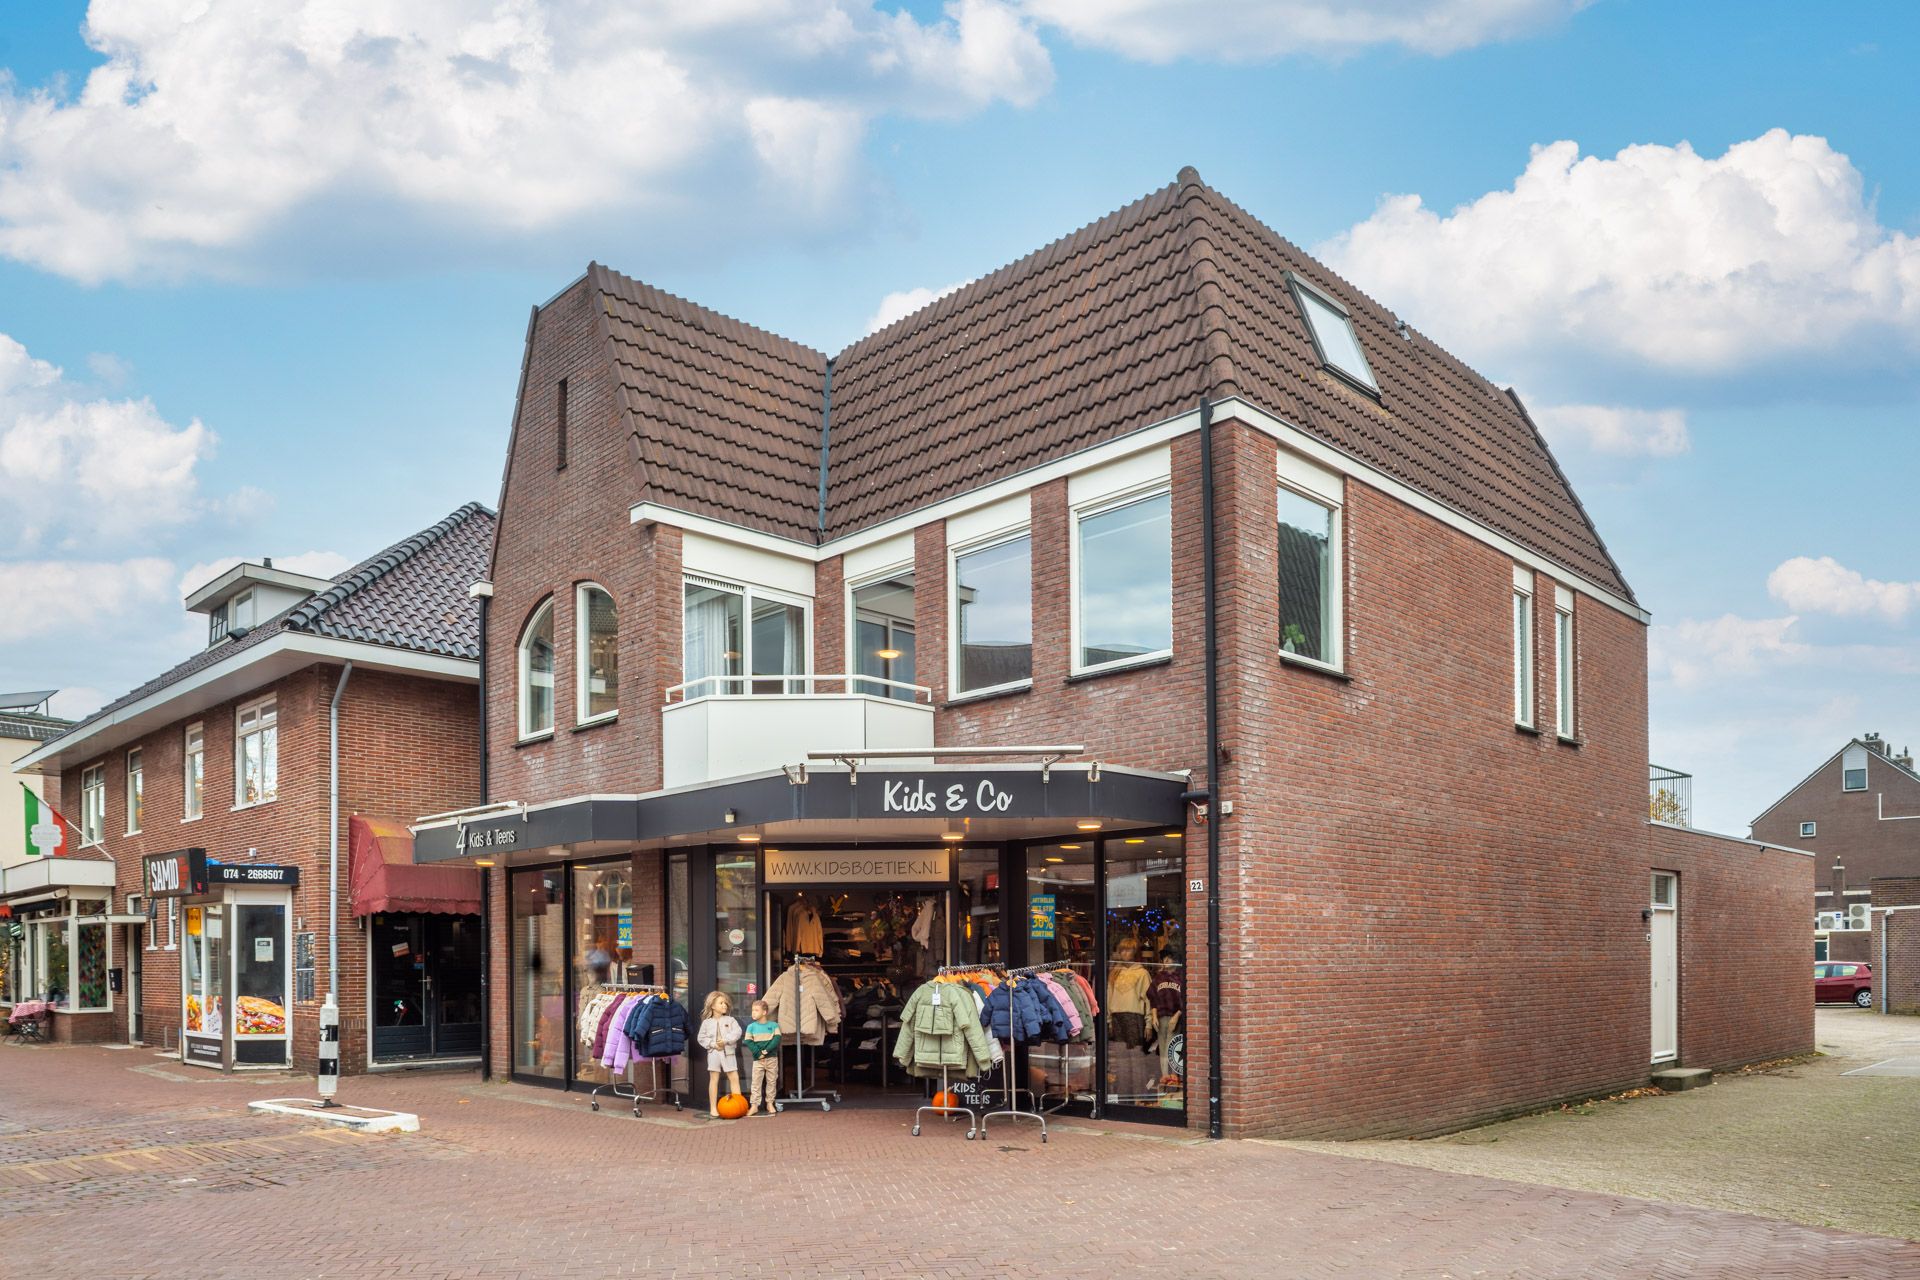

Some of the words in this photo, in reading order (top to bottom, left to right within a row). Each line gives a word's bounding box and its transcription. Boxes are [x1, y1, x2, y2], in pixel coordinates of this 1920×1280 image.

[883, 779, 937, 812] Kids
[945, 784, 968, 811] &
[976, 780, 1013, 811] Co
[456, 825, 466, 855] 4
[469, 832, 484, 848] Kids
[486, 830, 493, 846] &
[494, 829, 515, 845] Teens
[223, 868, 239, 879] 074
[247, 869, 284, 880] 2668507
[771, 861, 942, 875] WWW.KIDSBOETIEK.NL
[1191, 882, 1202, 890] 22
[1032, 915, 1054, 929] 30%
[953, 1082, 976, 1093] KIDS
